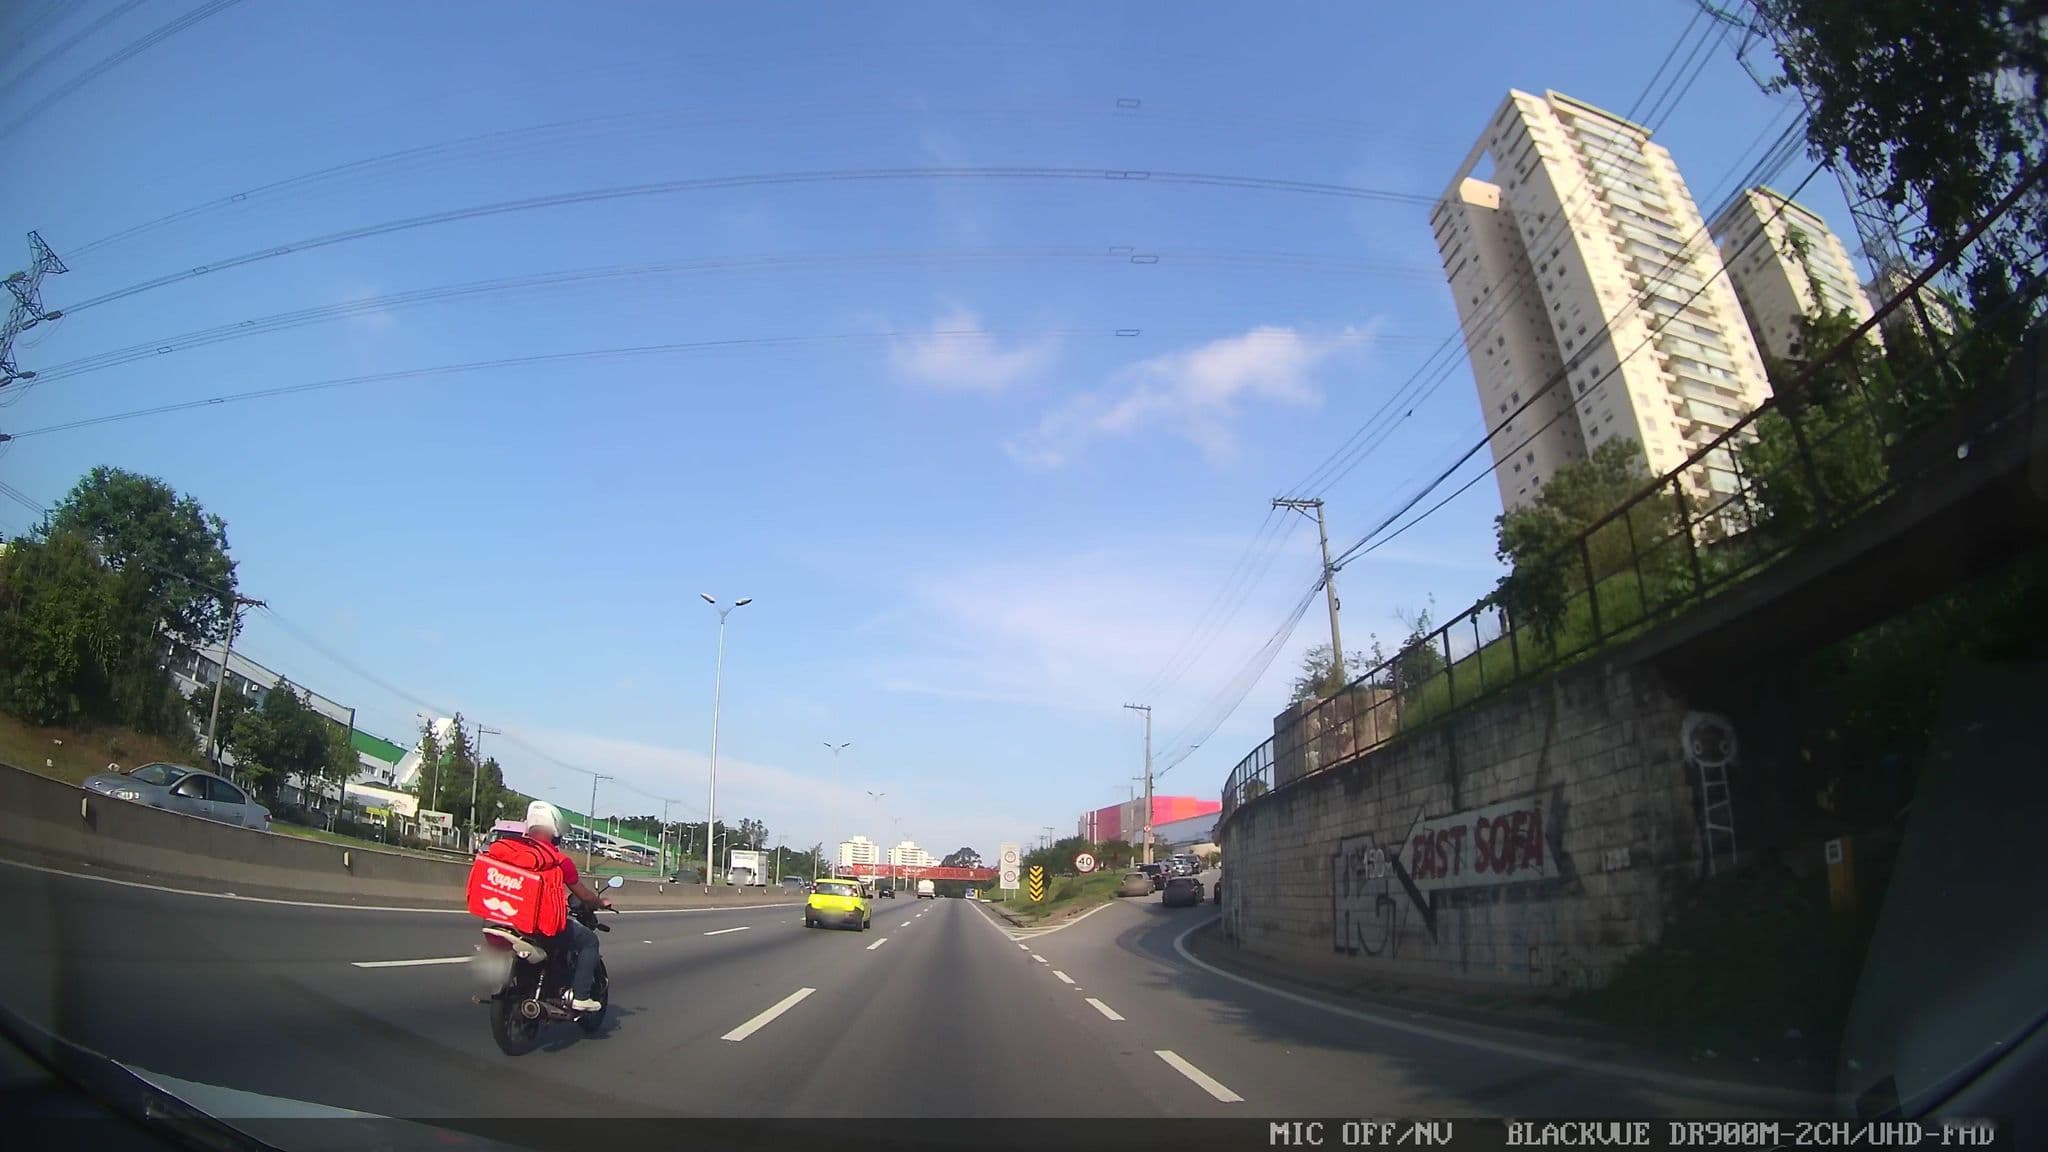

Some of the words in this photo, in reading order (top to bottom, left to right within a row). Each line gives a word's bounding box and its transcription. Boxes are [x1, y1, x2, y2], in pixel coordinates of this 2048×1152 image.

[1411, 824, 1467, 881] FAST
[1474, 807, 1546, 876] SOFA
[1079, 857, 1092, 865] 40
[487, 866, 525, 891] Rappi
